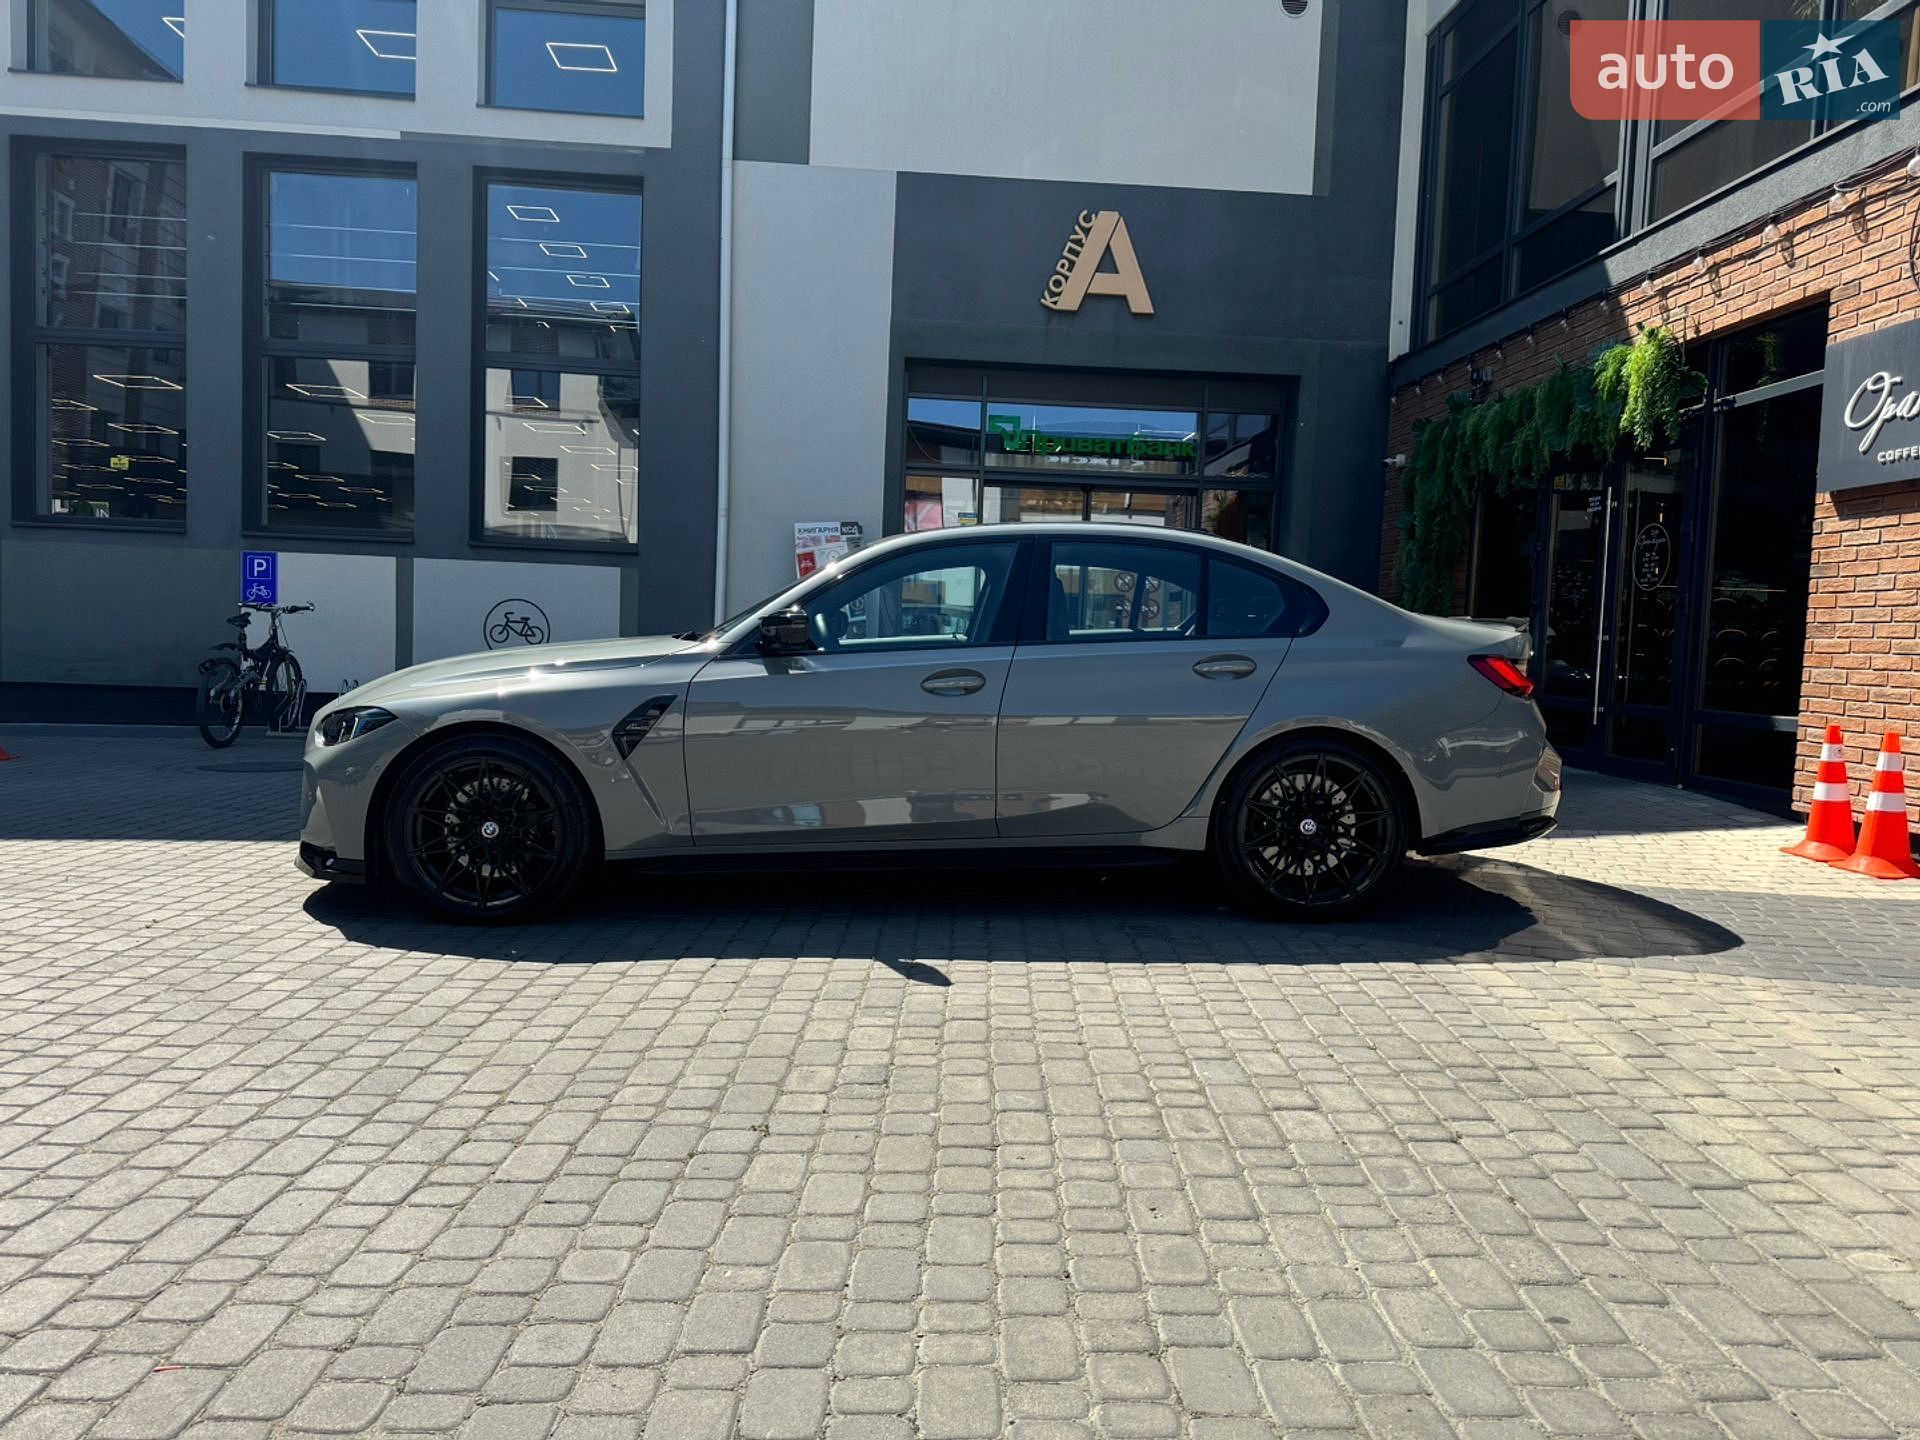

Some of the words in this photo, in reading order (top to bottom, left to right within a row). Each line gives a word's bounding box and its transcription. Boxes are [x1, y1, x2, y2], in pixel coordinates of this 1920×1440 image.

[1040, 209, 1096, 309] КОРПУС
[1877, 445, 1920, 463] COFFE
[253, 558, 267, 577] P
